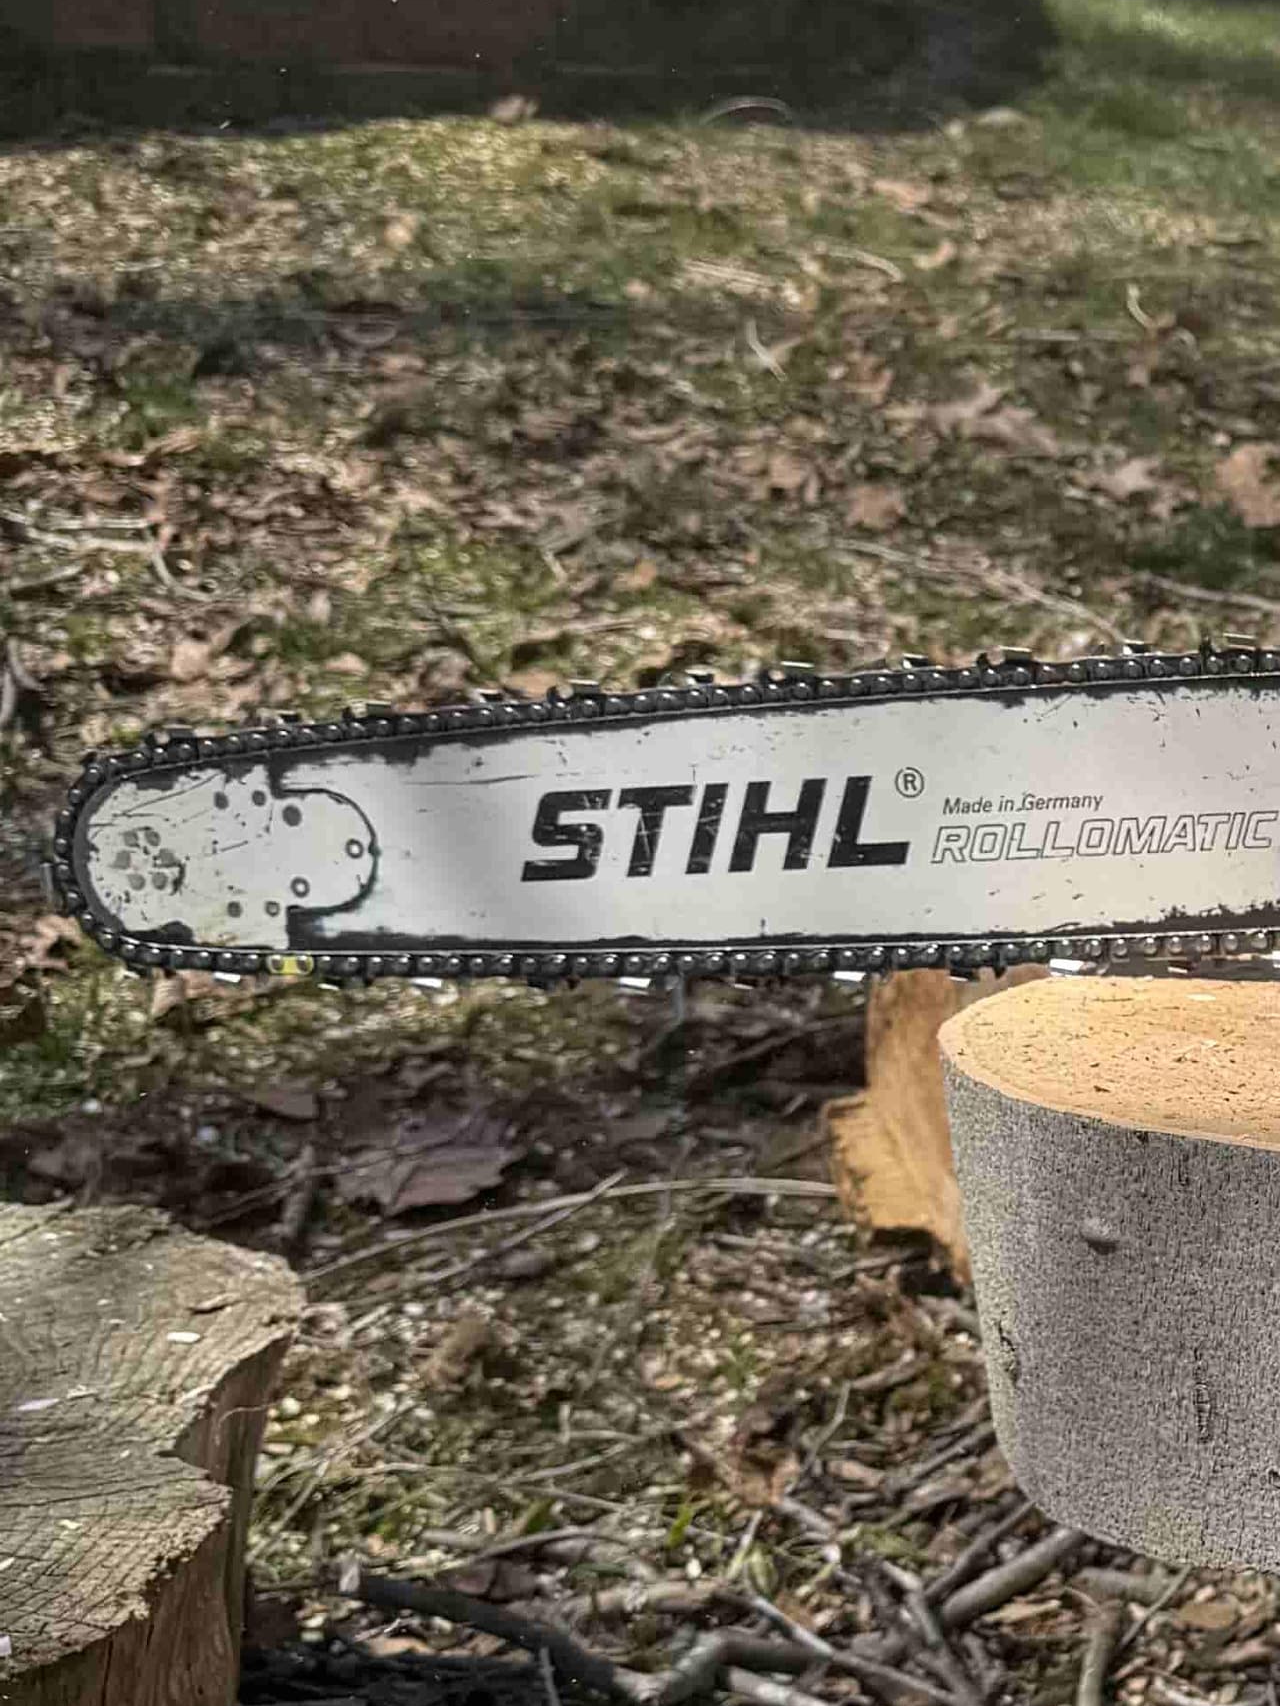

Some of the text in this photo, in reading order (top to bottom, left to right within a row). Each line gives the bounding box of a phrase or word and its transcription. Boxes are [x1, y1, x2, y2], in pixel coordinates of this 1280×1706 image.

[942, 793, 1104, 815] Made in Germany
[930, 810, 1280, 864] ROLLOMATIC
